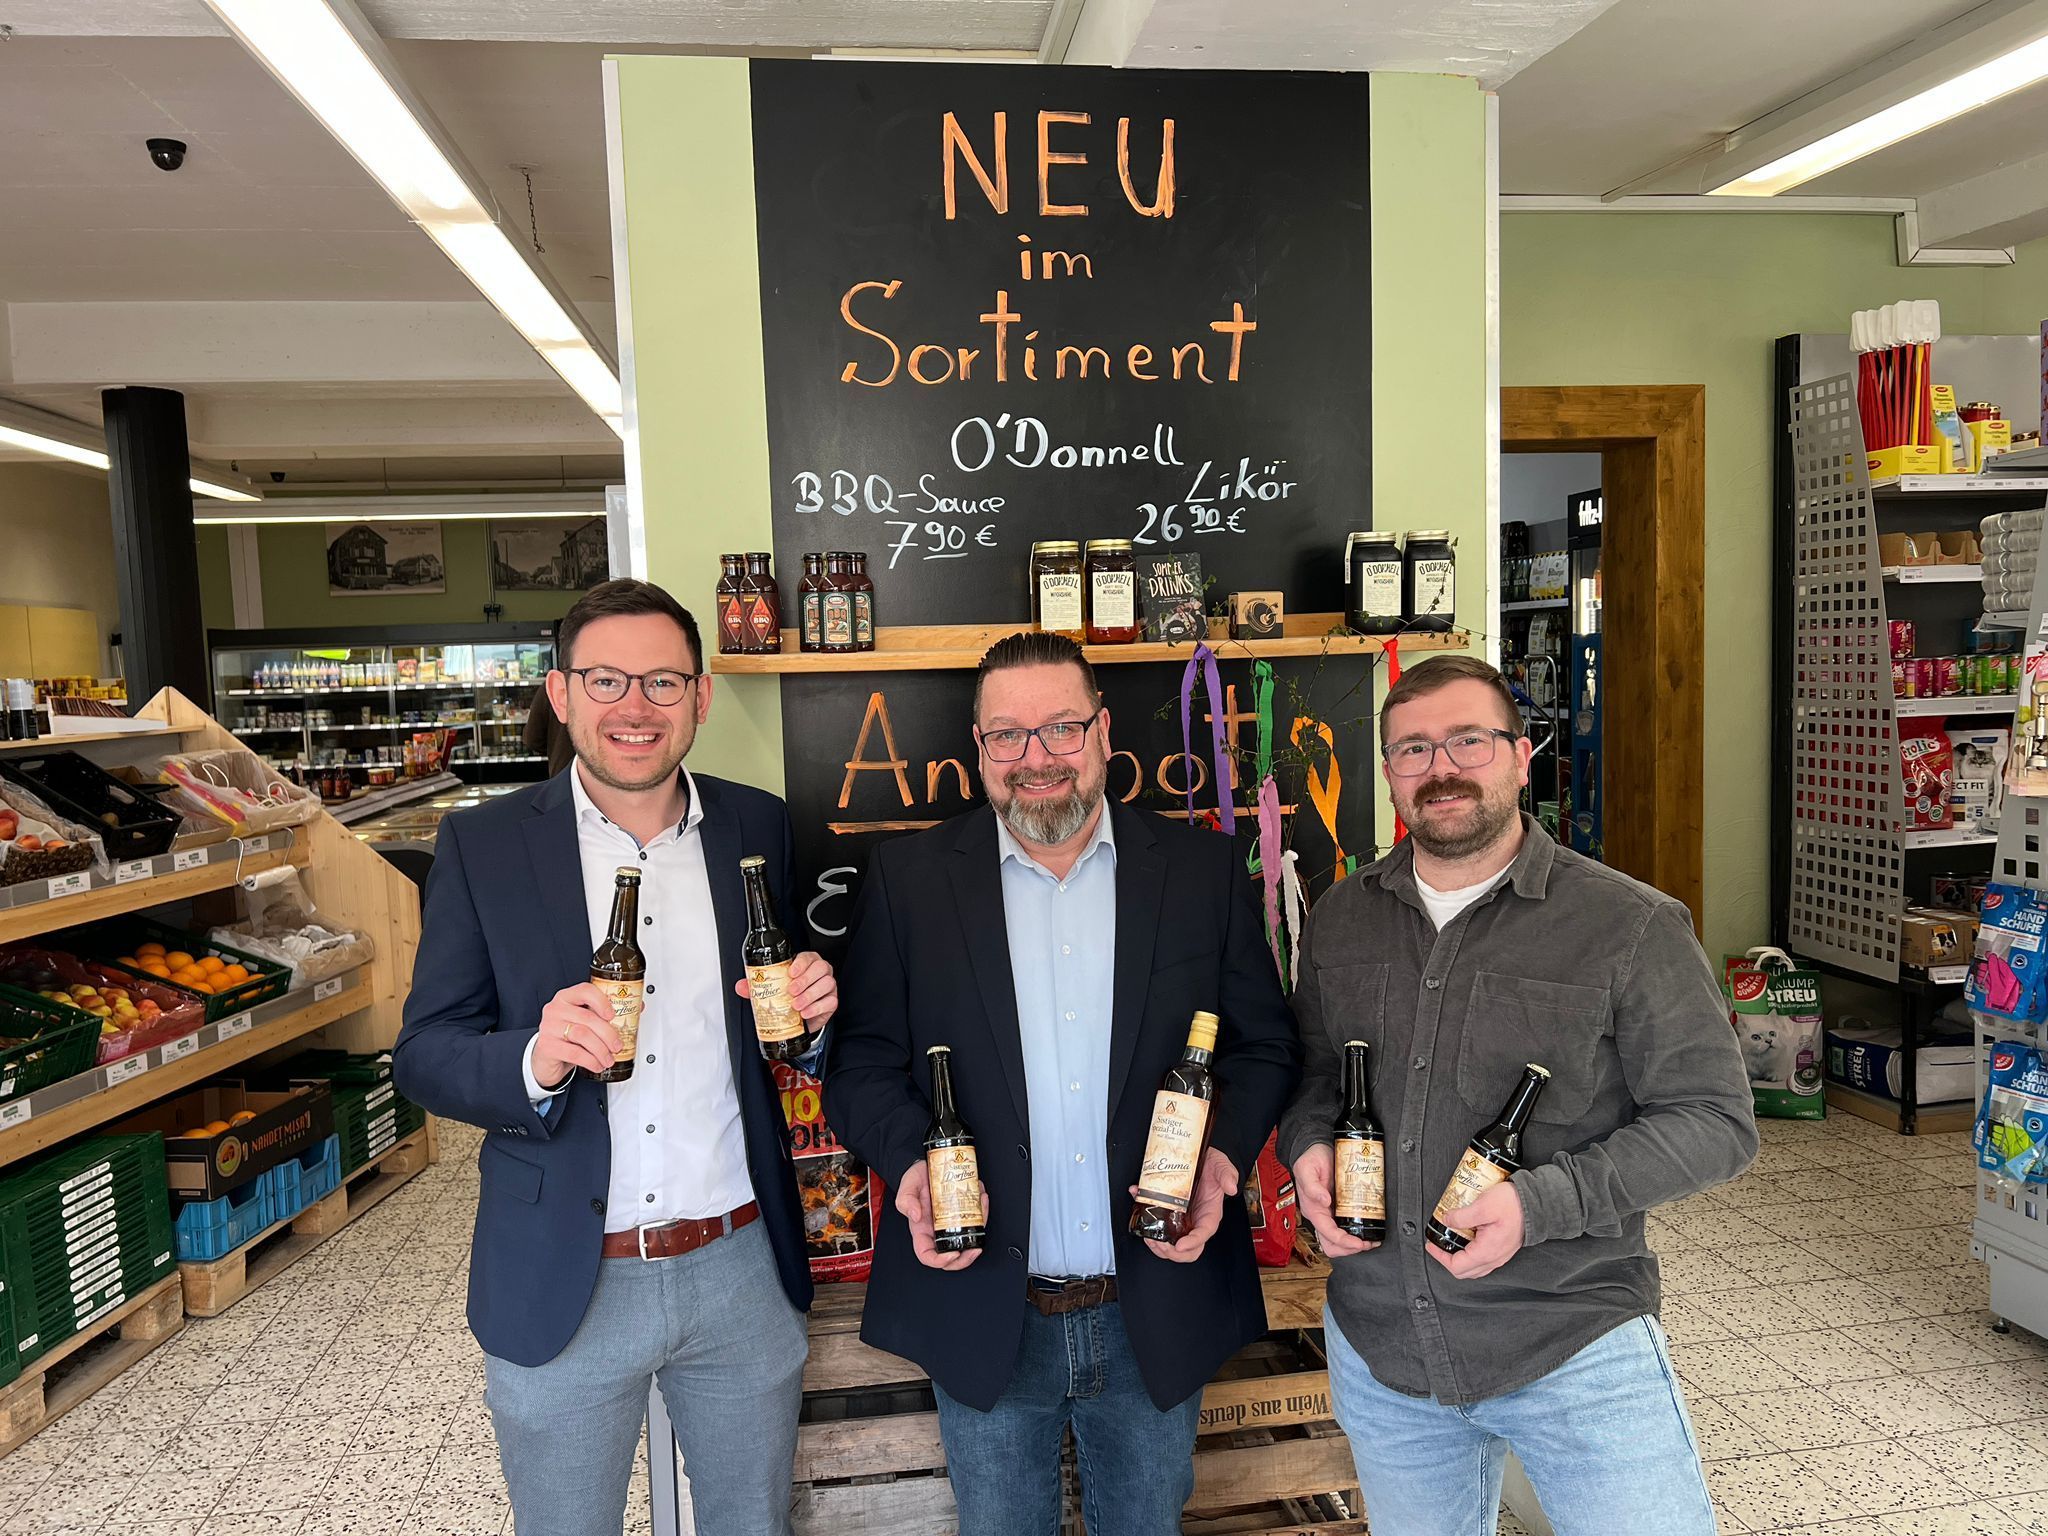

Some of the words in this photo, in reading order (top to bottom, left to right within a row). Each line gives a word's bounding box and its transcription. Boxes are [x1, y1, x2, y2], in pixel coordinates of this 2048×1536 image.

[942, 109, 1177, 220] NEU
[1017, 233, 1094, 281] im
[839, 279, 1258, 387] Sortiment
[950, 412, 1185, 473] O'Donnell
[1184, 456, 1298, 503] Likör
[791, 469, 1006, 516] BBQ-Sauce
[1148, 573, 1194, 598] DRINKS
[753, 616, 770, 624] BBQ
[1970, 781, 1985, 790] FIT
[2013, 910, 2046, 926] HAND
[1775, 978, 1815, 989] KLUMP
[1766, 988, 1817, 1003] STREU
[1853, 1046, 1866, 1088] STREU
[2010, 1078, 2048, 1095] SCHUH
[2021, 1071, 2048, 1086] HAN
[1157, 1157, 1190, 1171] Emma
[1251, 1398, 1282, 1418] aus
[1285, 1392, 1330, 1417] Wein
